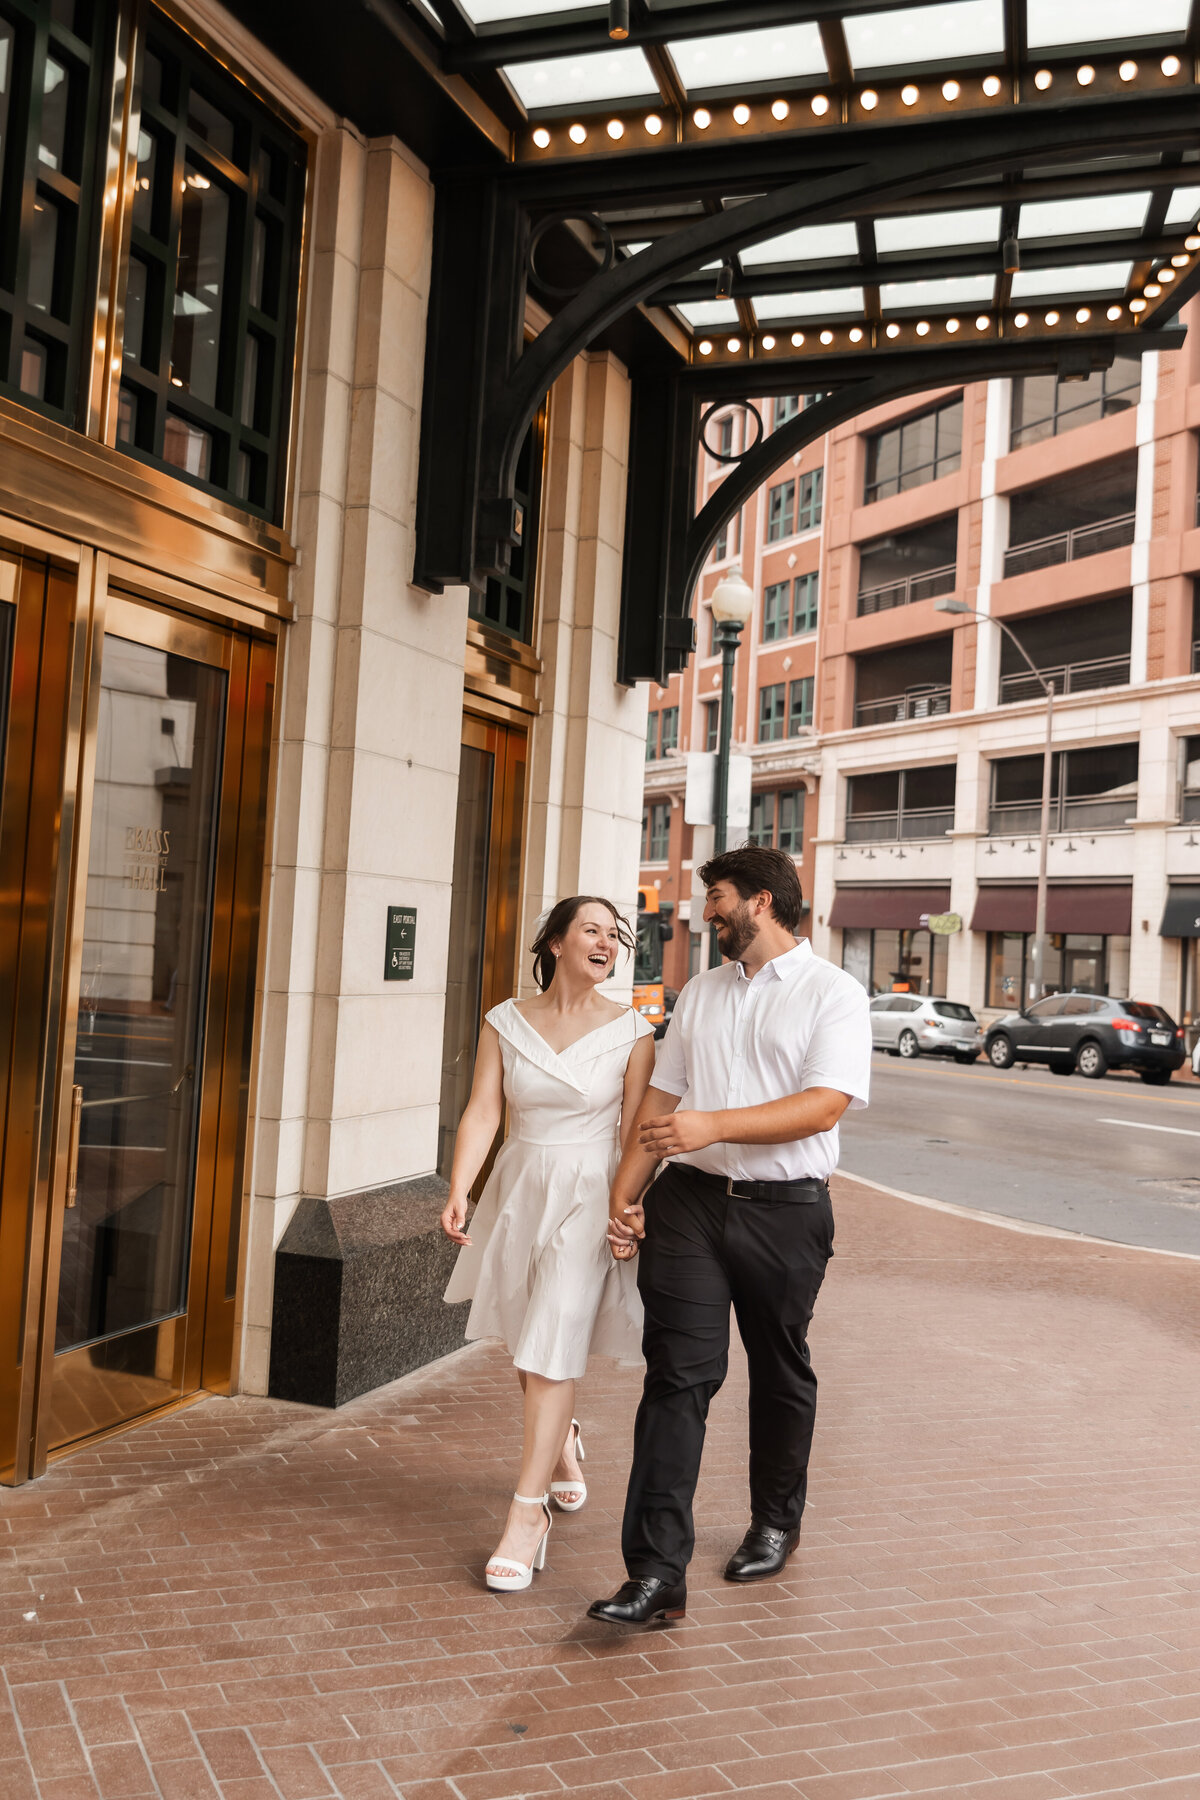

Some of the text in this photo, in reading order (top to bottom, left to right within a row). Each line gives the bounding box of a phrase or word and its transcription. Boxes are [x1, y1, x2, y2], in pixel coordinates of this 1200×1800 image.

[135, 827, 170, 854] BASS
[132, 866, 167, 891] HALL
[393, 914, 402, 924] EAST
